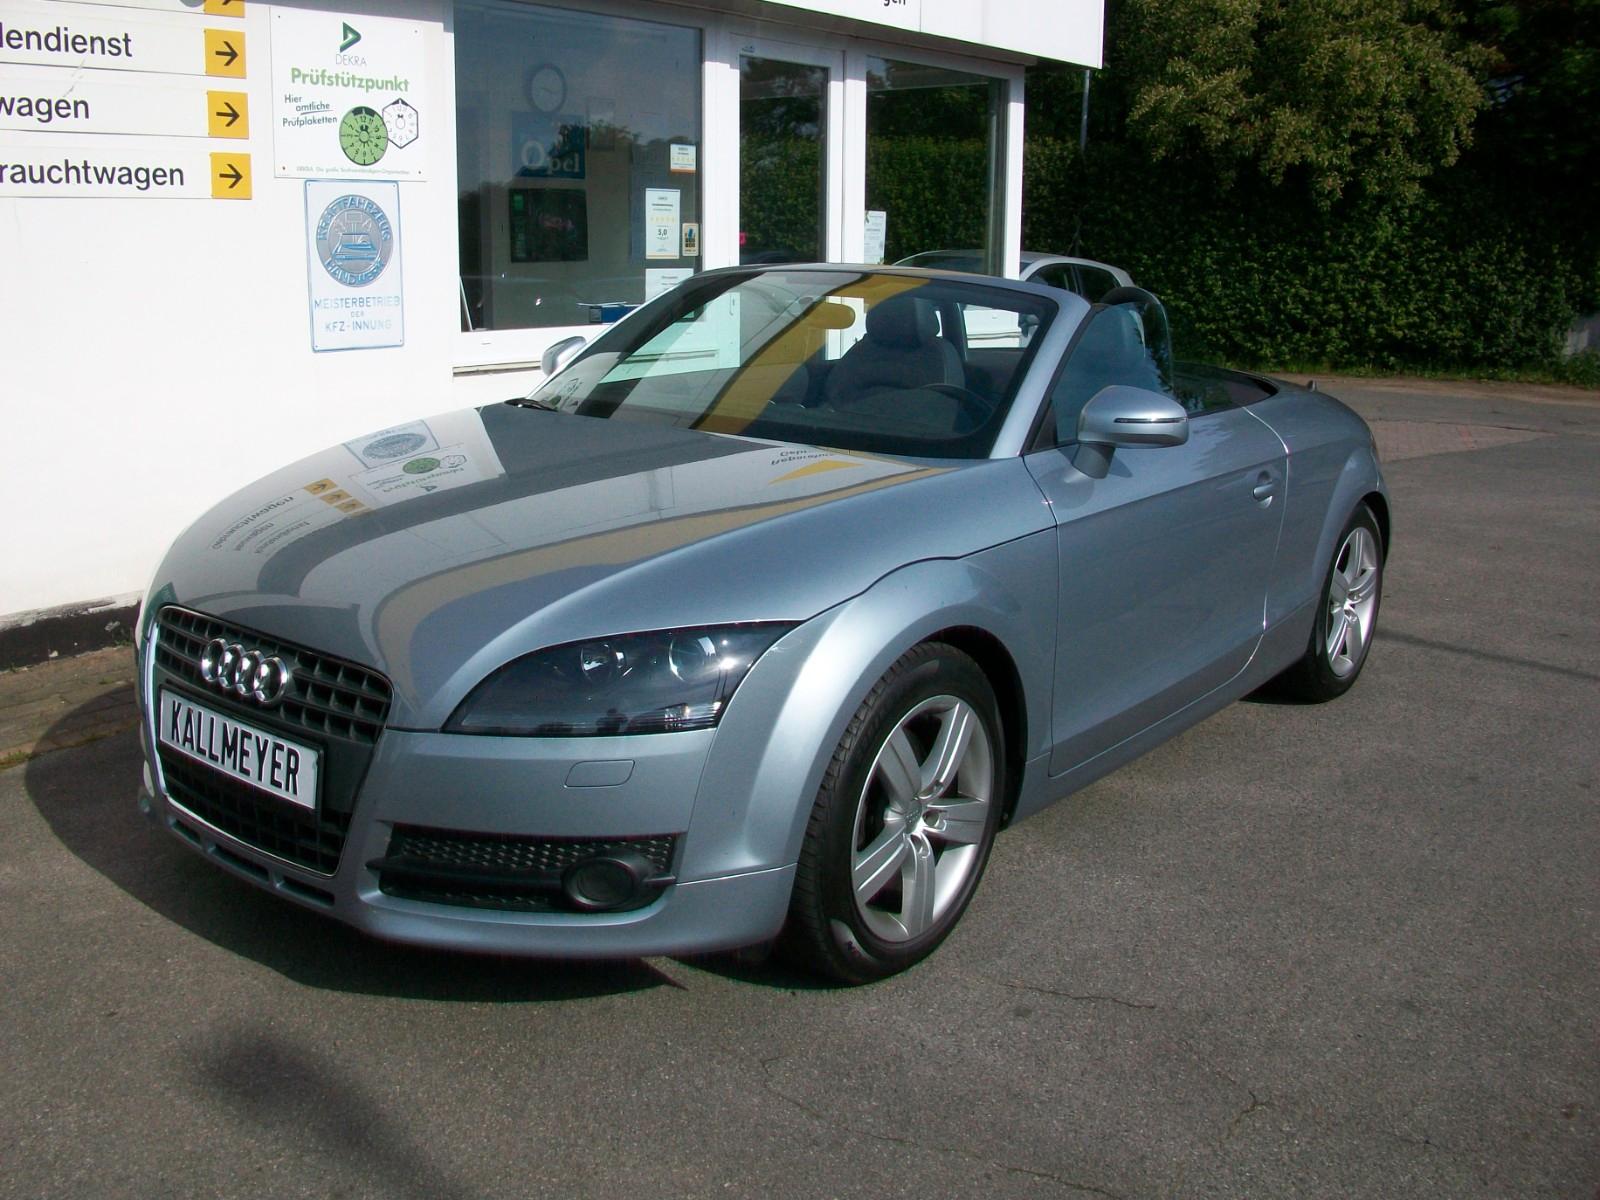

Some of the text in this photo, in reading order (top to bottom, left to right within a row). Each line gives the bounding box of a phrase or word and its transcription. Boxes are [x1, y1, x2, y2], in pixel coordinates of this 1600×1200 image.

[0, 21, 133, 57] endienst
[335, 53, 368, 67] DEKRA
[290, 66, 410, 93] Prüfstützpunkt
[284, 93, 303, 104] Hier
[295, 101, 331, 112] amtliche
[282, 116, 338, 128] Prüfplaketten
[314, 295, 401, 310] MEISTERBETRIEB
[324, 319, 393, 333] KFZ-INNUNG
[171, 699, 301, 797] KALLMEYER
